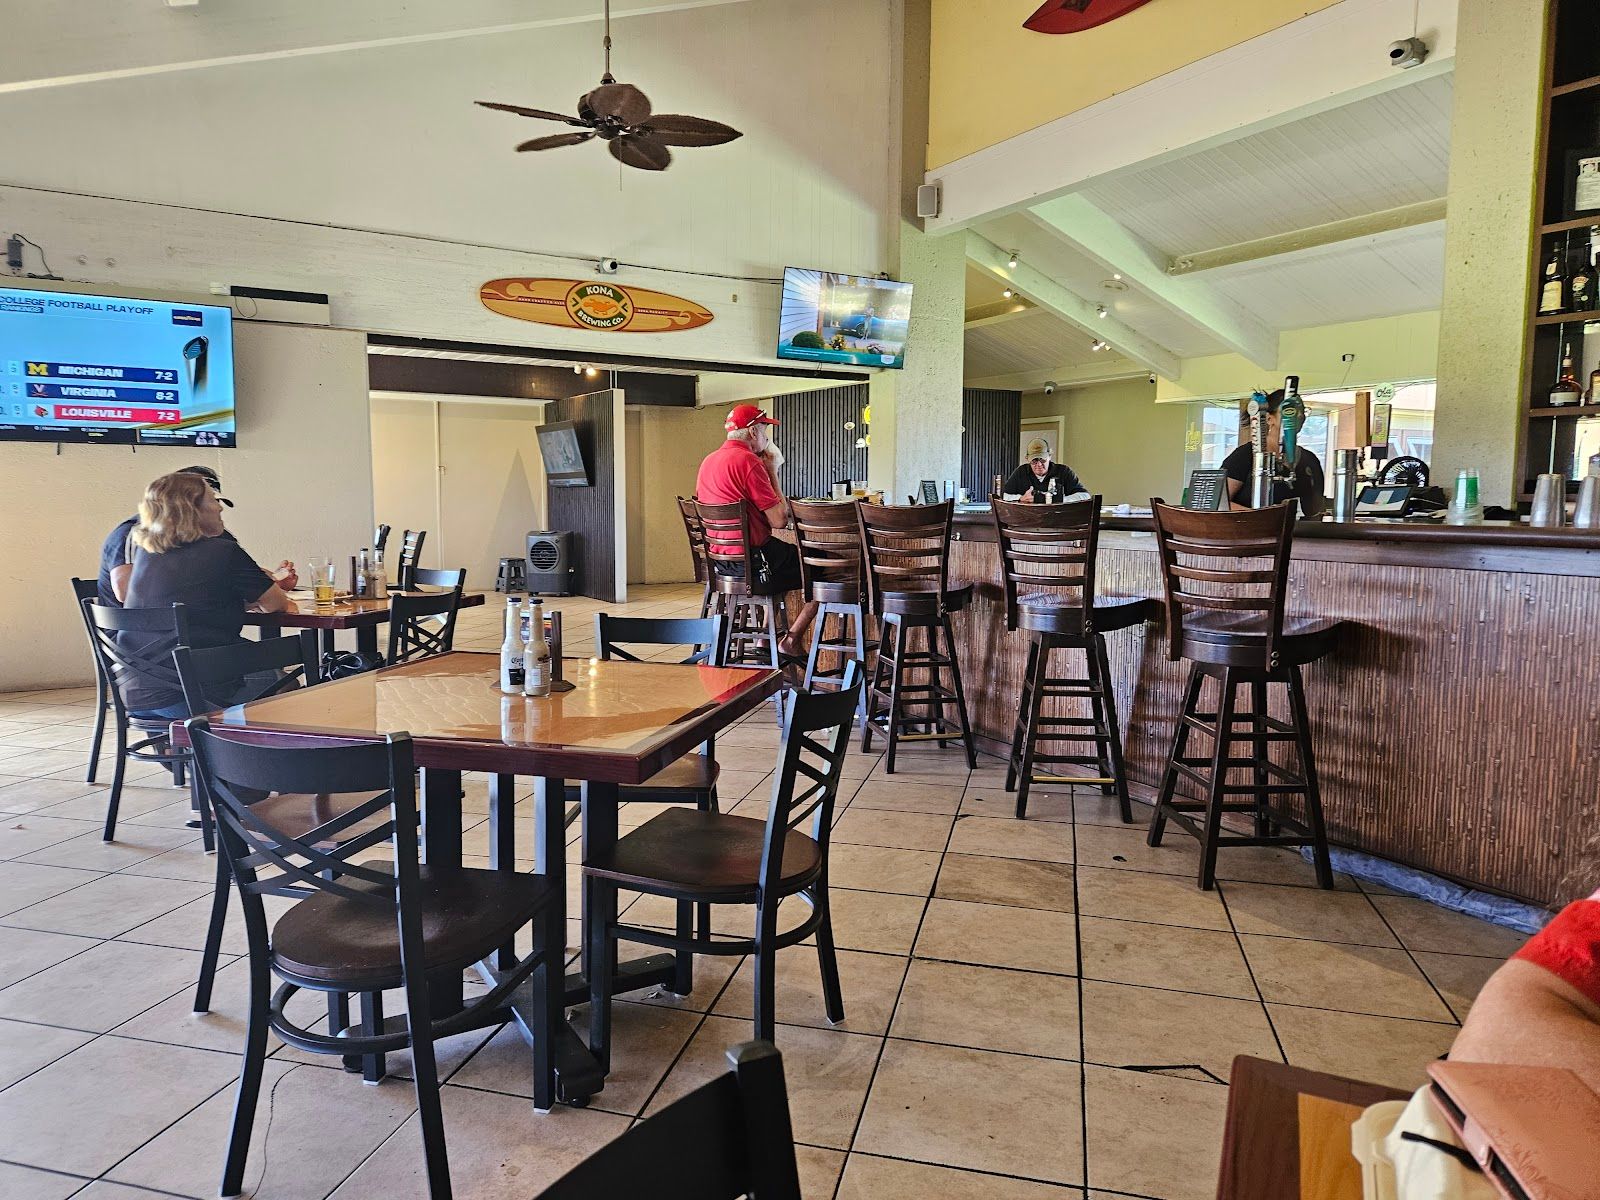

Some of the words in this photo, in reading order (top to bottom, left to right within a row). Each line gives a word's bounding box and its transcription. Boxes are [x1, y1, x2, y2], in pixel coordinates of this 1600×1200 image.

[586, 286, 614, 297] KONA
[48, 300, 103, 311] FOOTBALL
[106, 304, 154, 315] PLAYOFF
[577, 310, 612, 327] BREWING
[58, 365, 124, 378] MICHIGAN
[154, 371, 173, 381] 7-2
[60, 386, 117, 398] VIRGINIA
[155, 391, 174, 401] 8-2
[61, 407, 132, 419] LOUISVILLE
[157, 411, 176, 421] 7-2
